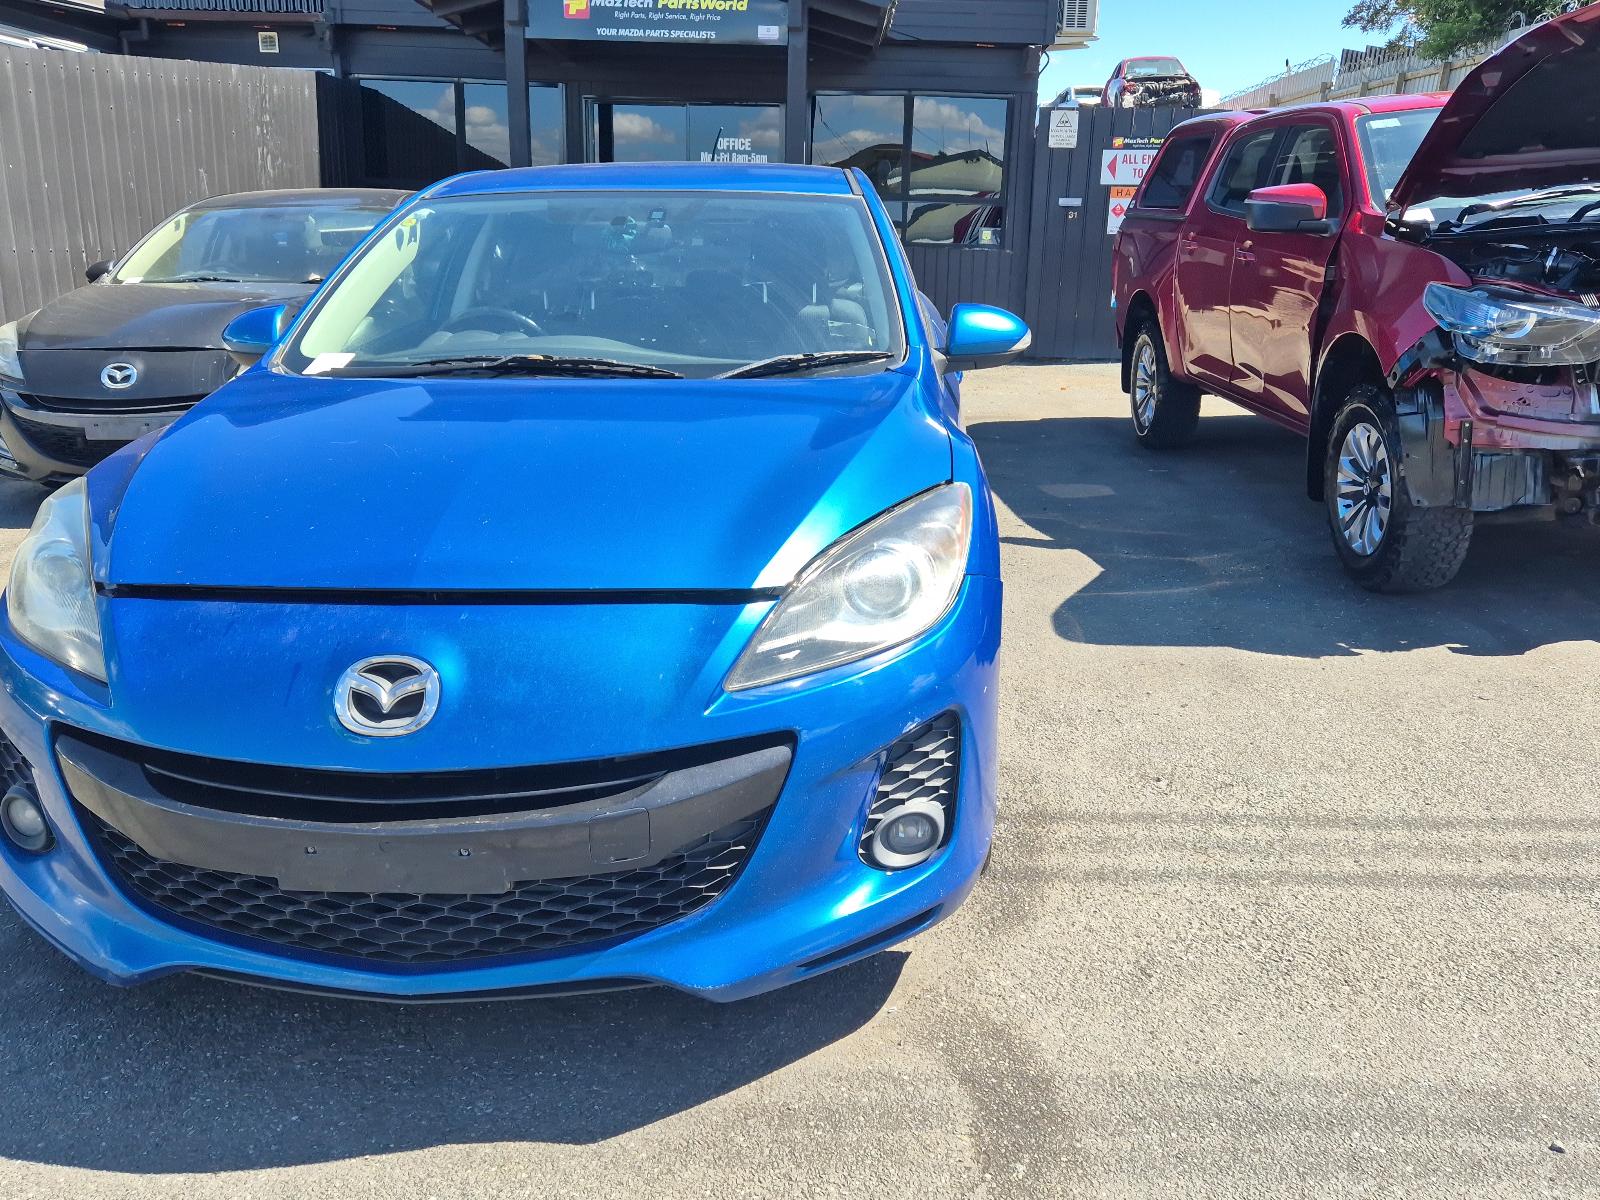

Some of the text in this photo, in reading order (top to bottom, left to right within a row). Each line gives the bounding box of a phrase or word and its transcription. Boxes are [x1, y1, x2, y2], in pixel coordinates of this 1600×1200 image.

[657, 0, 748, 10] PartsWorld
[614, 11, 630, 19] Right
[648, 12, 664, 20] Right
[665, 12, 688, 20] Service,
[690, 13, 705, 21] Right
[596, 28, 717, 39] YOUR MAZDA PARTS SPECIALISTS
[717, 138, 751, 151] OFFICE
[1122, 154, 1156, 165] ALL EN
[1132, 168, 1144, 179] TO
[1116, 188, 1137, 197] HA
[1068, 211, 1078, 219] 31
